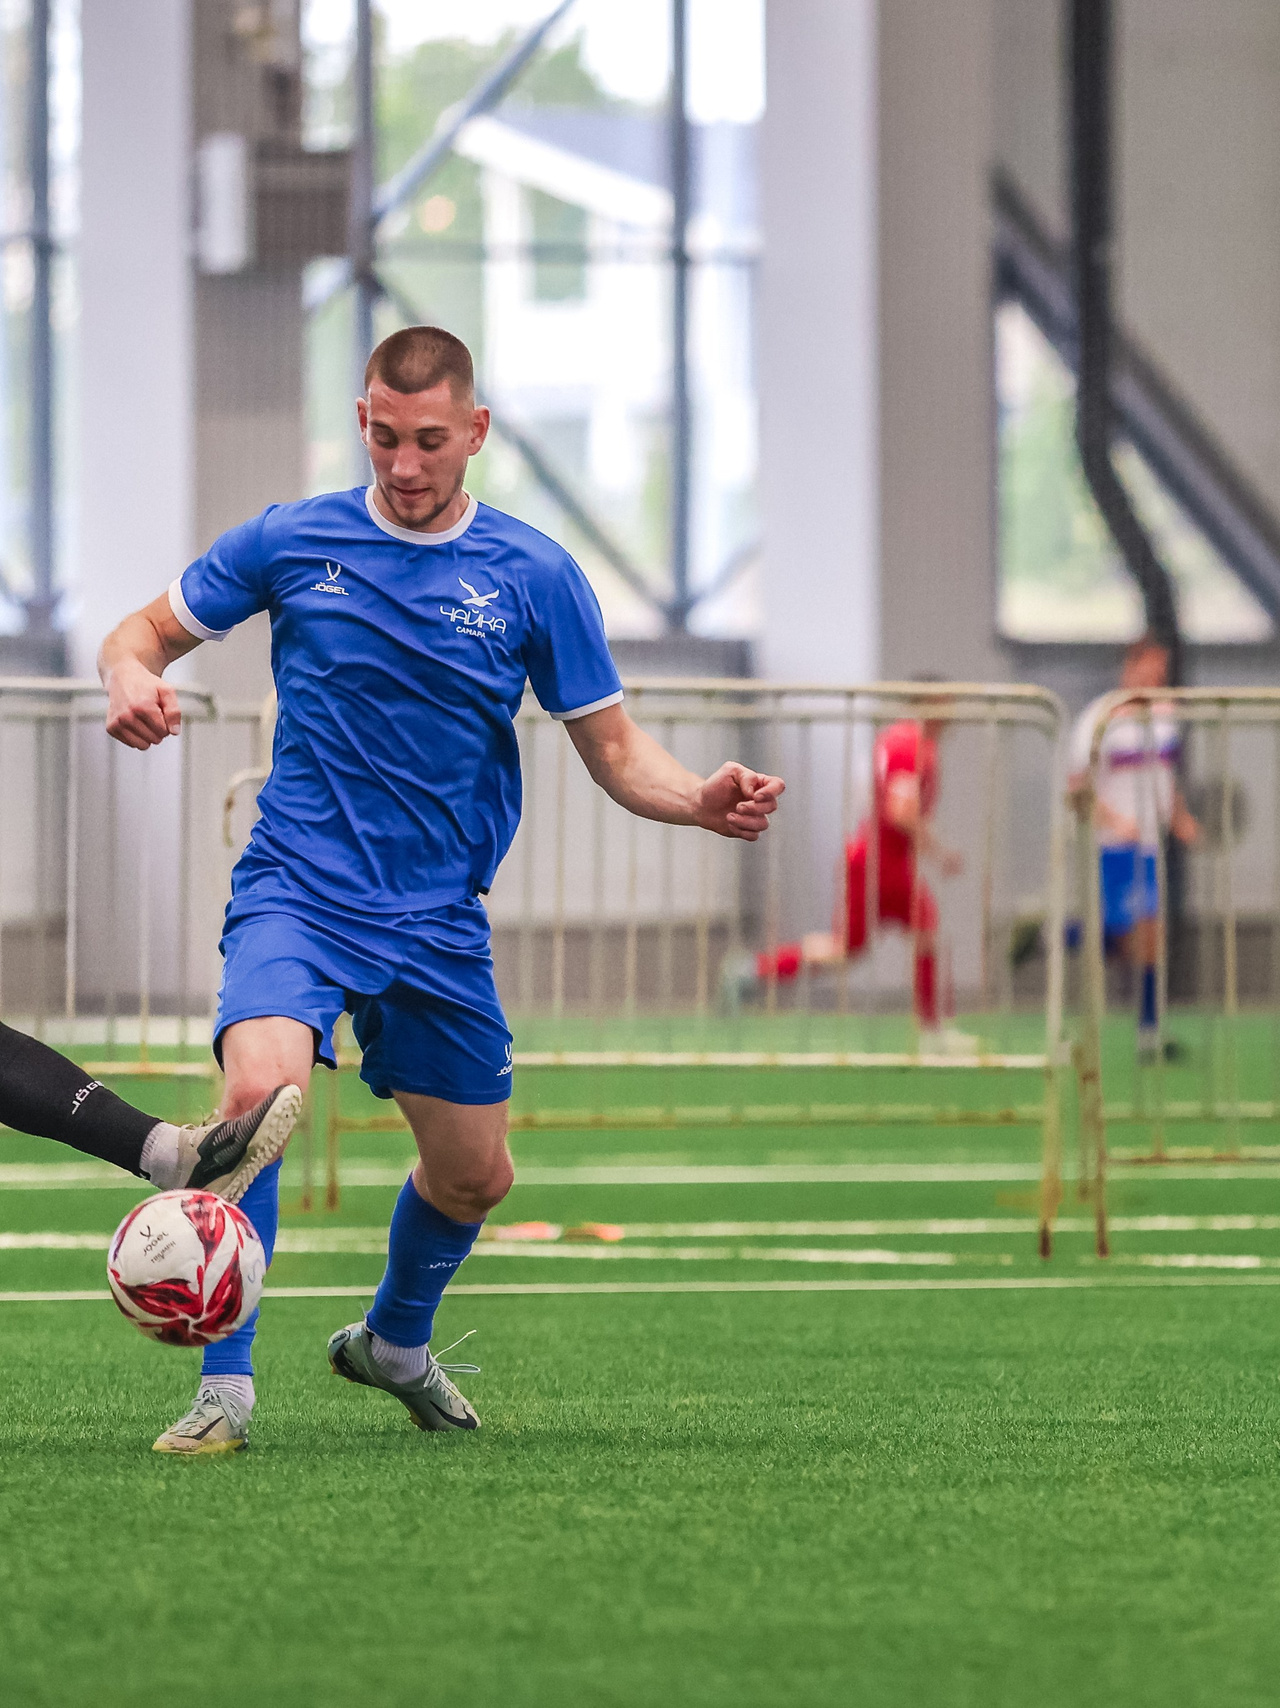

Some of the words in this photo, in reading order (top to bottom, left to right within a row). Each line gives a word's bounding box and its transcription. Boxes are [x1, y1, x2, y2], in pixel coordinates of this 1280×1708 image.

[310, 582, 349, 596] JÖGEL
[440, 605, 507, 634] ЧАЙКА
[456, 626, 486, 639] САМАРА
[72, 1080, 104, 1115] JÖG
